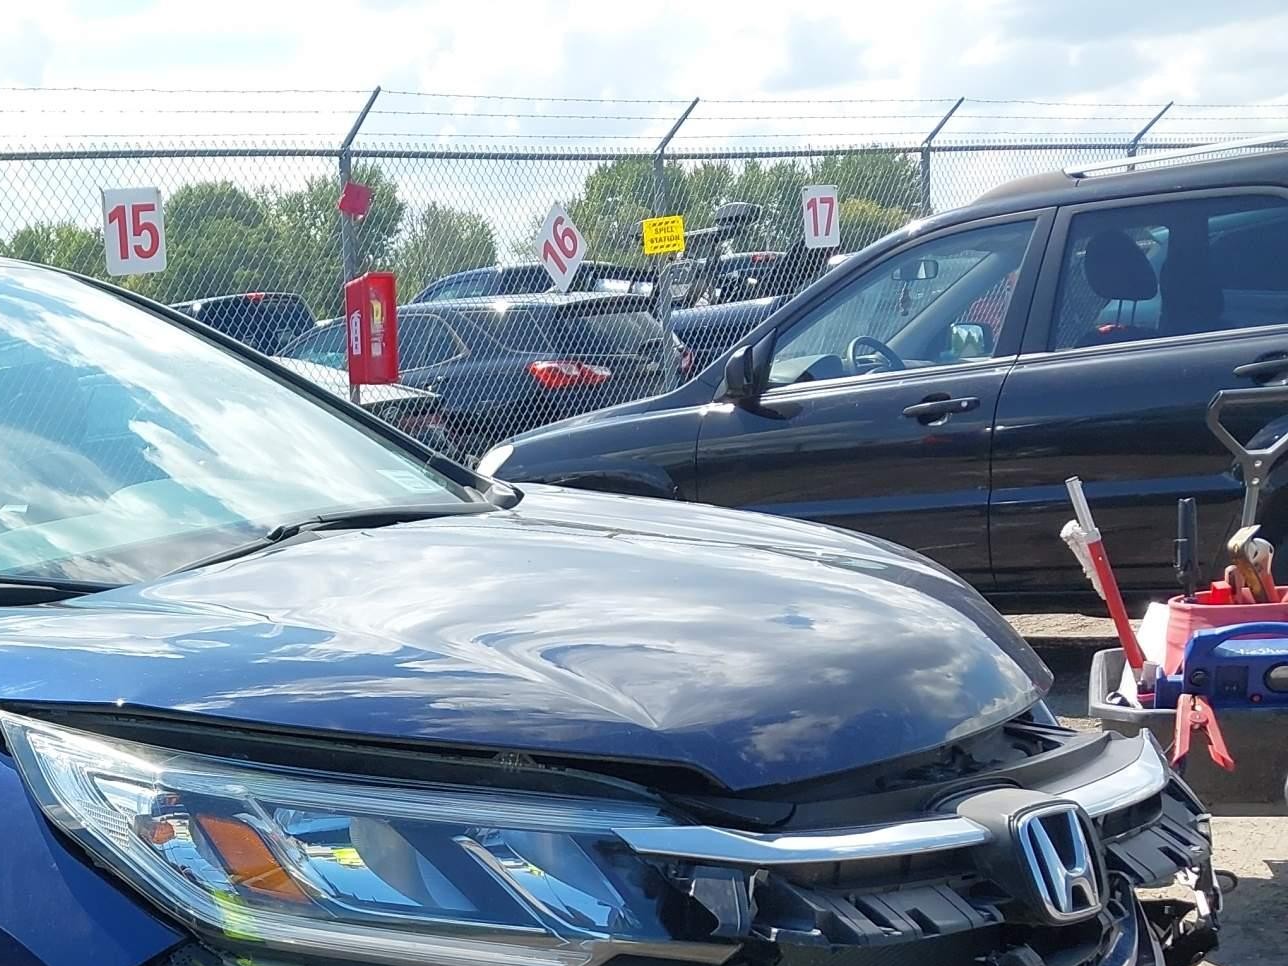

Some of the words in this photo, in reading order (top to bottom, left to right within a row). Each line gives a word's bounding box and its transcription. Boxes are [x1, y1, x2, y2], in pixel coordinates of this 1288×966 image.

[108, 203, 160, 260] 15
[654, 226, 675, 235] SPILL
[807, 197, 834, 237] 17
[543, 216, 578, 275] 16
[649, 234, 681, 244] STATION
